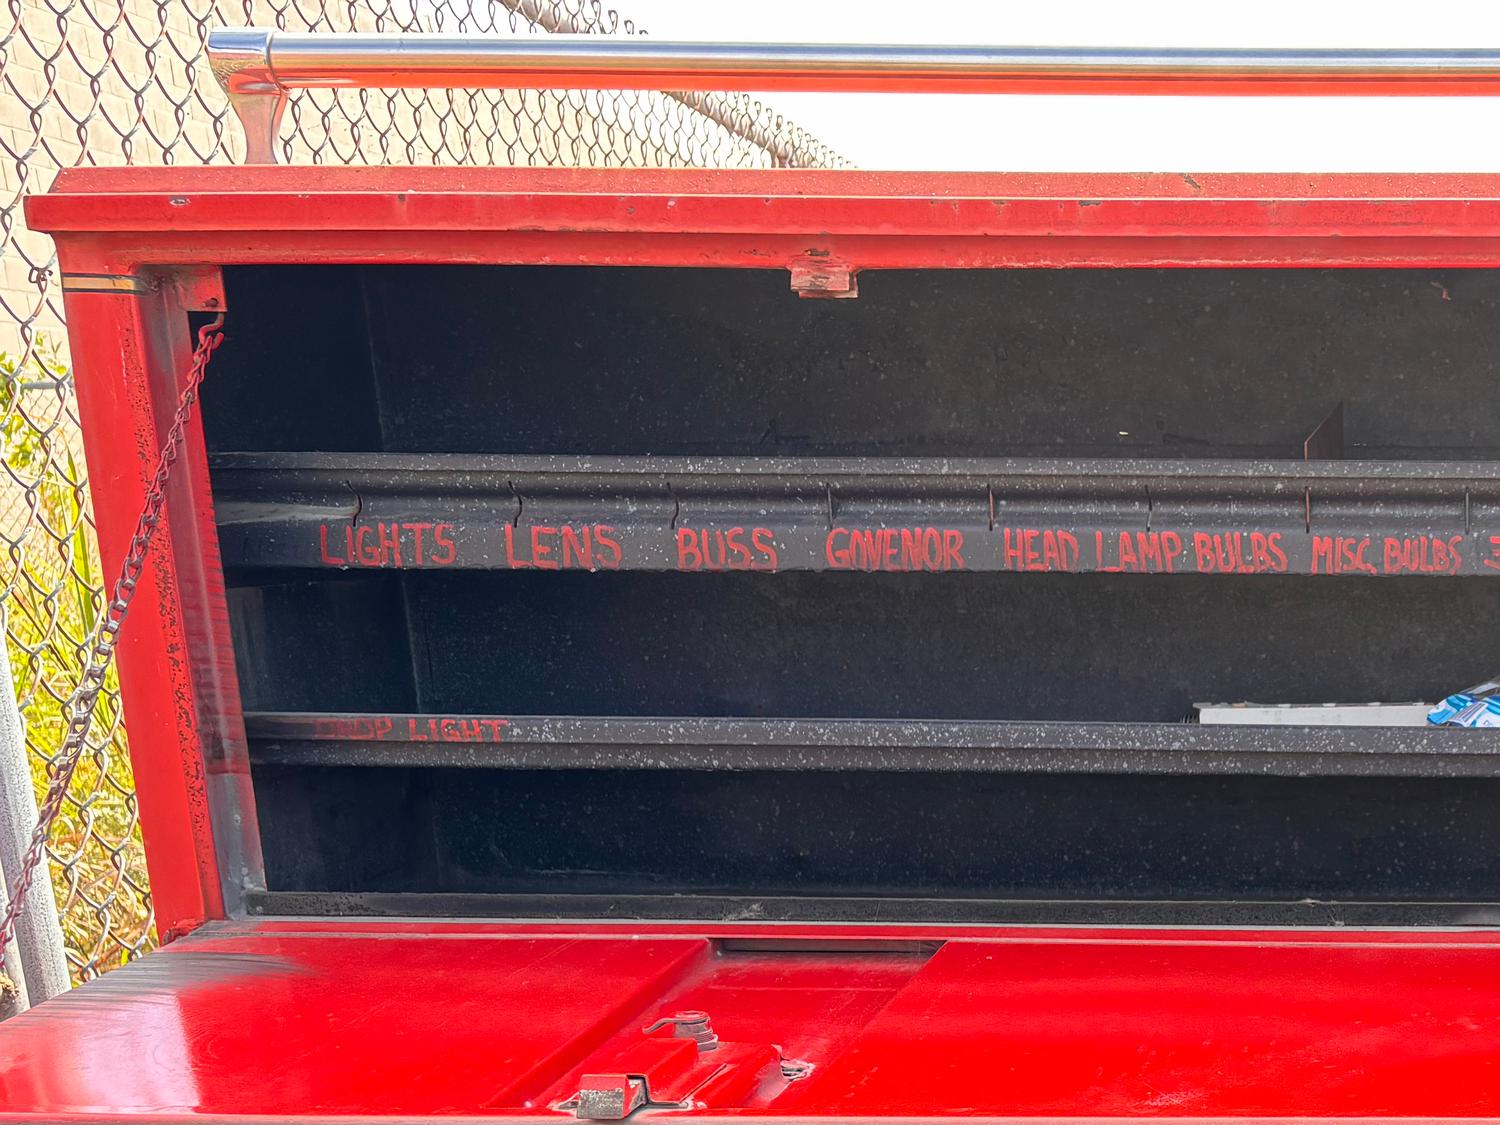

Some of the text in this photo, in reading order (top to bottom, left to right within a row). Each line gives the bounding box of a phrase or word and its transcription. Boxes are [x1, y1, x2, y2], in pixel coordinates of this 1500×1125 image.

[319, 521, 457, 568] LIGHTS
[503, 522, 623, 570] LENS
[675, 526, 779, 571] BUSS
[824, 526, 965, 572] GOVENOR
[1002, 527, 1289, 575] HEAD LAMP BULBS
[1383, 534, 1464, 577] BULBS
[407, 717, 508, 744] LIGHT
